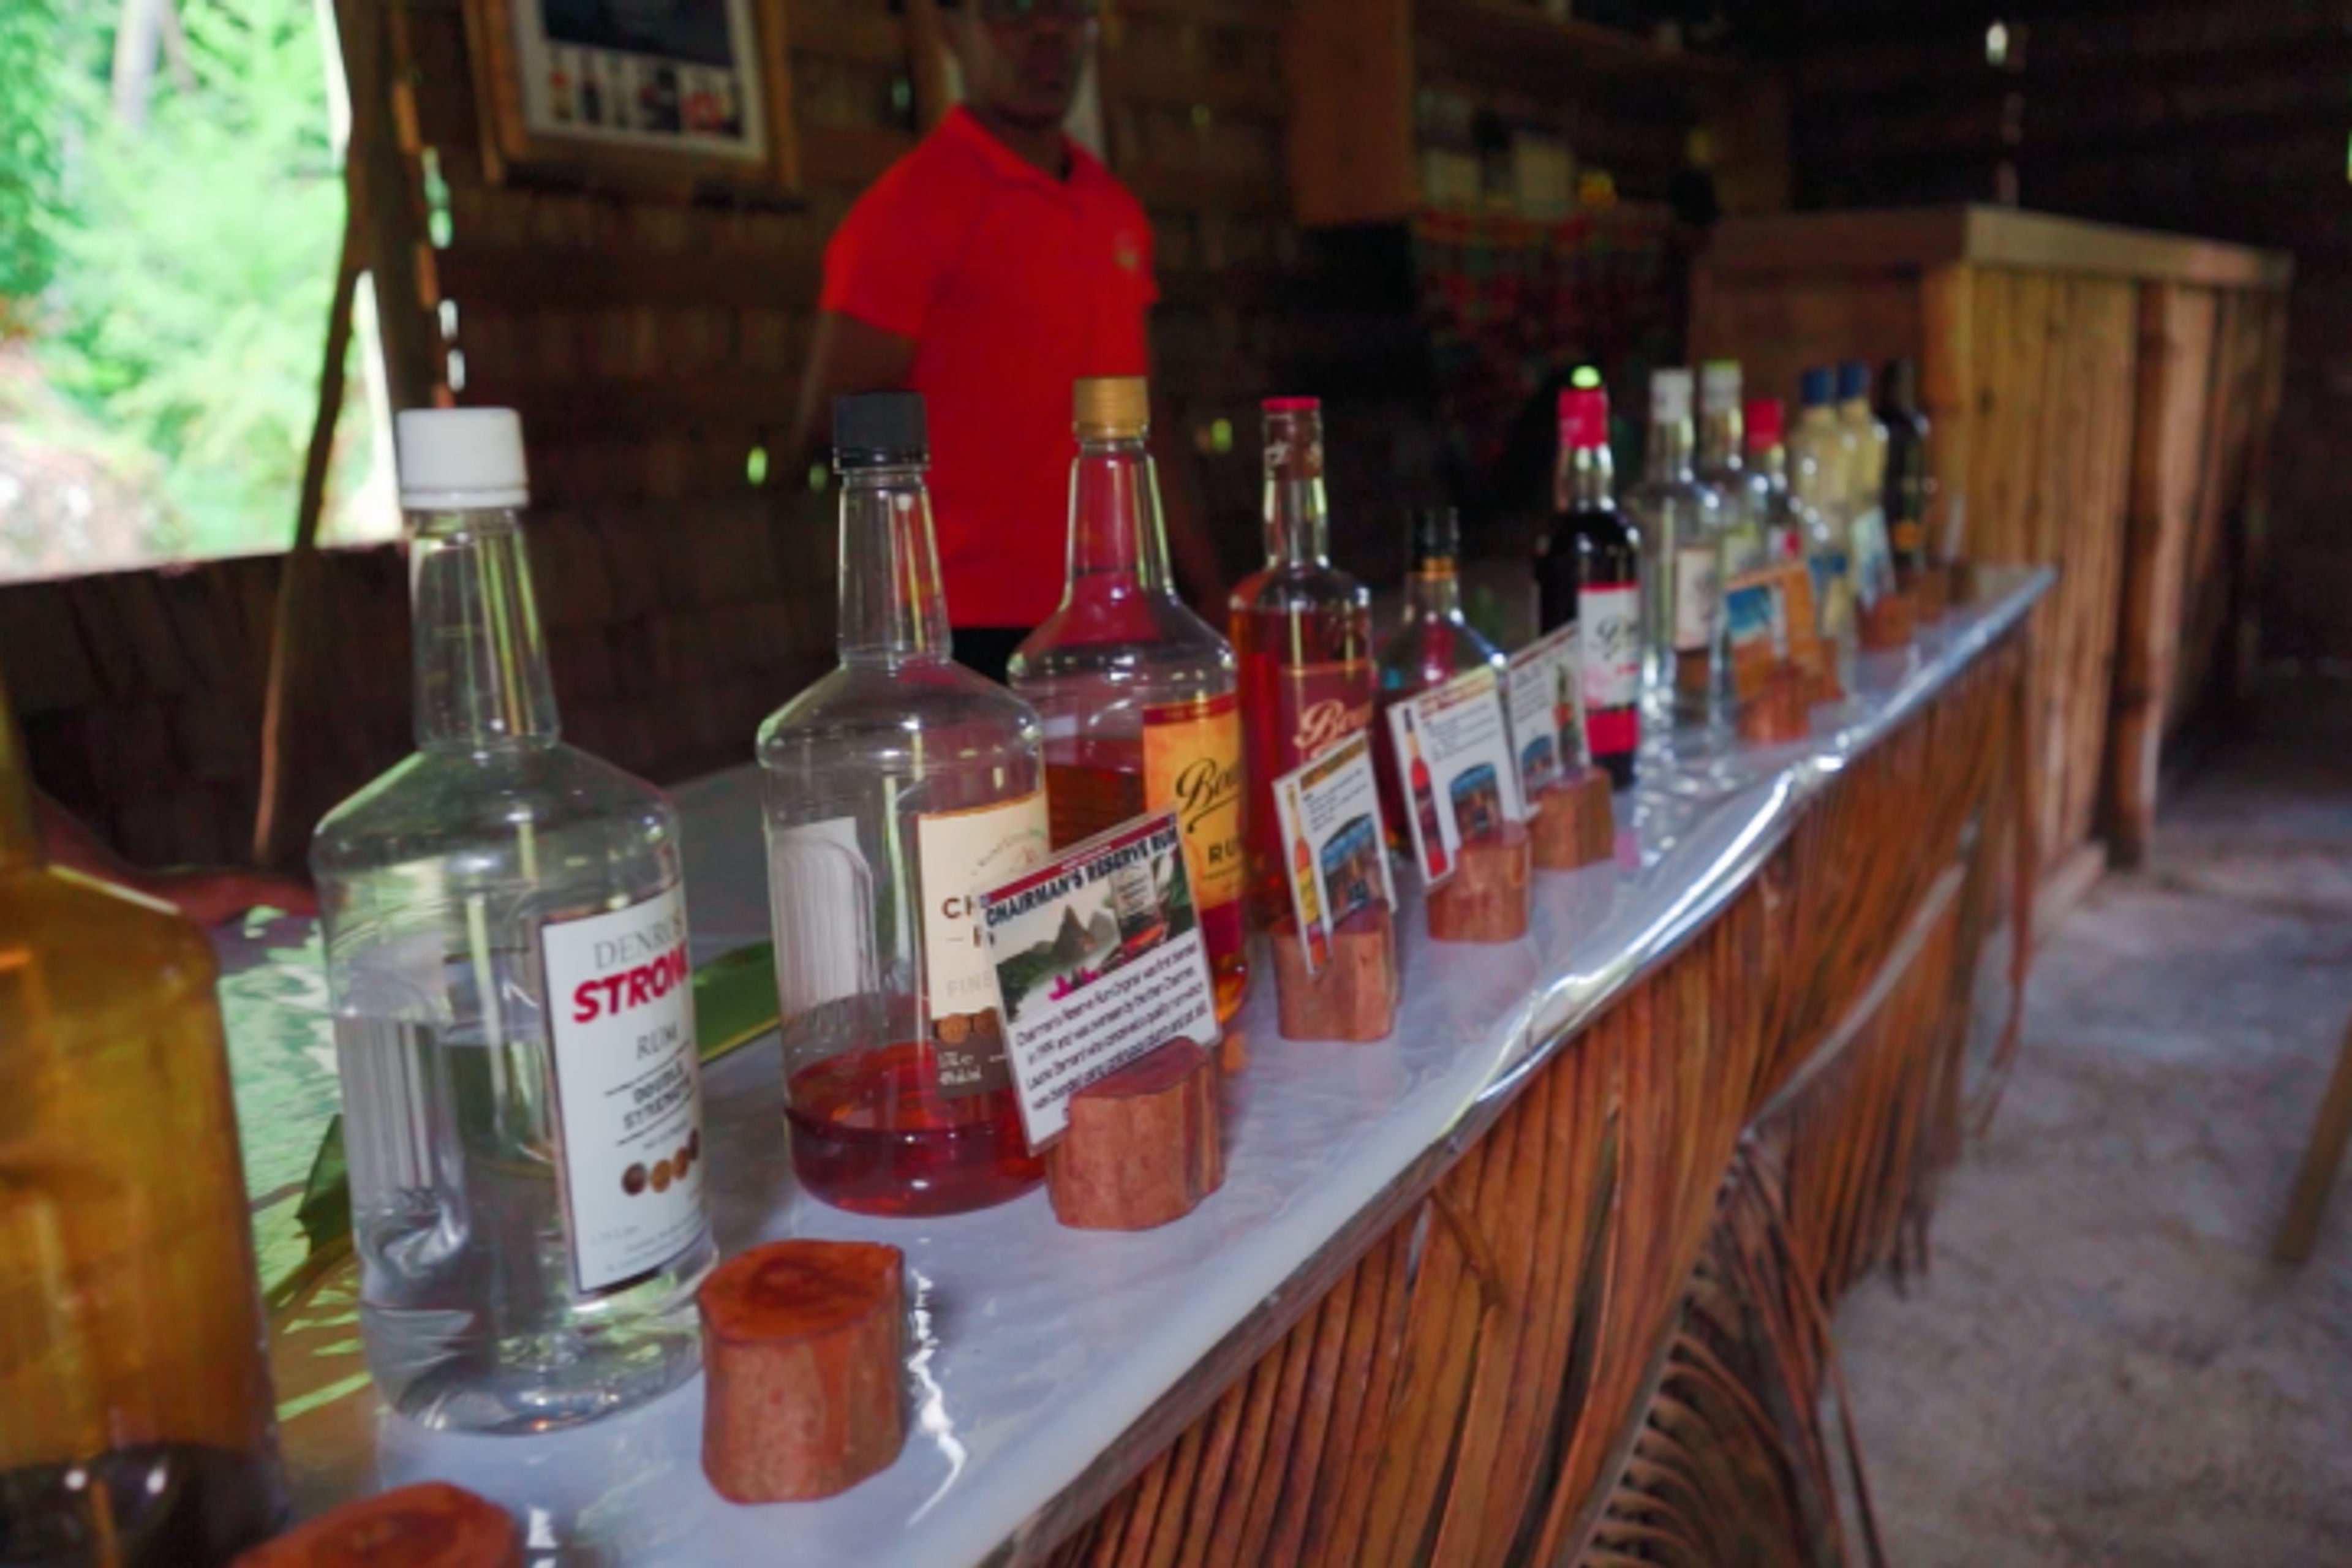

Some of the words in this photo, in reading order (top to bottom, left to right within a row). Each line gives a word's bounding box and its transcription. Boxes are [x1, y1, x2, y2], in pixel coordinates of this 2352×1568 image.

[986, 867, 1083, 926] CHAIRMAN'S
[1085, 835, 1150, 883] RESERVE
[1152, 824, 1177, 854] RUM
[572, 938, 688, 1024] STRON
